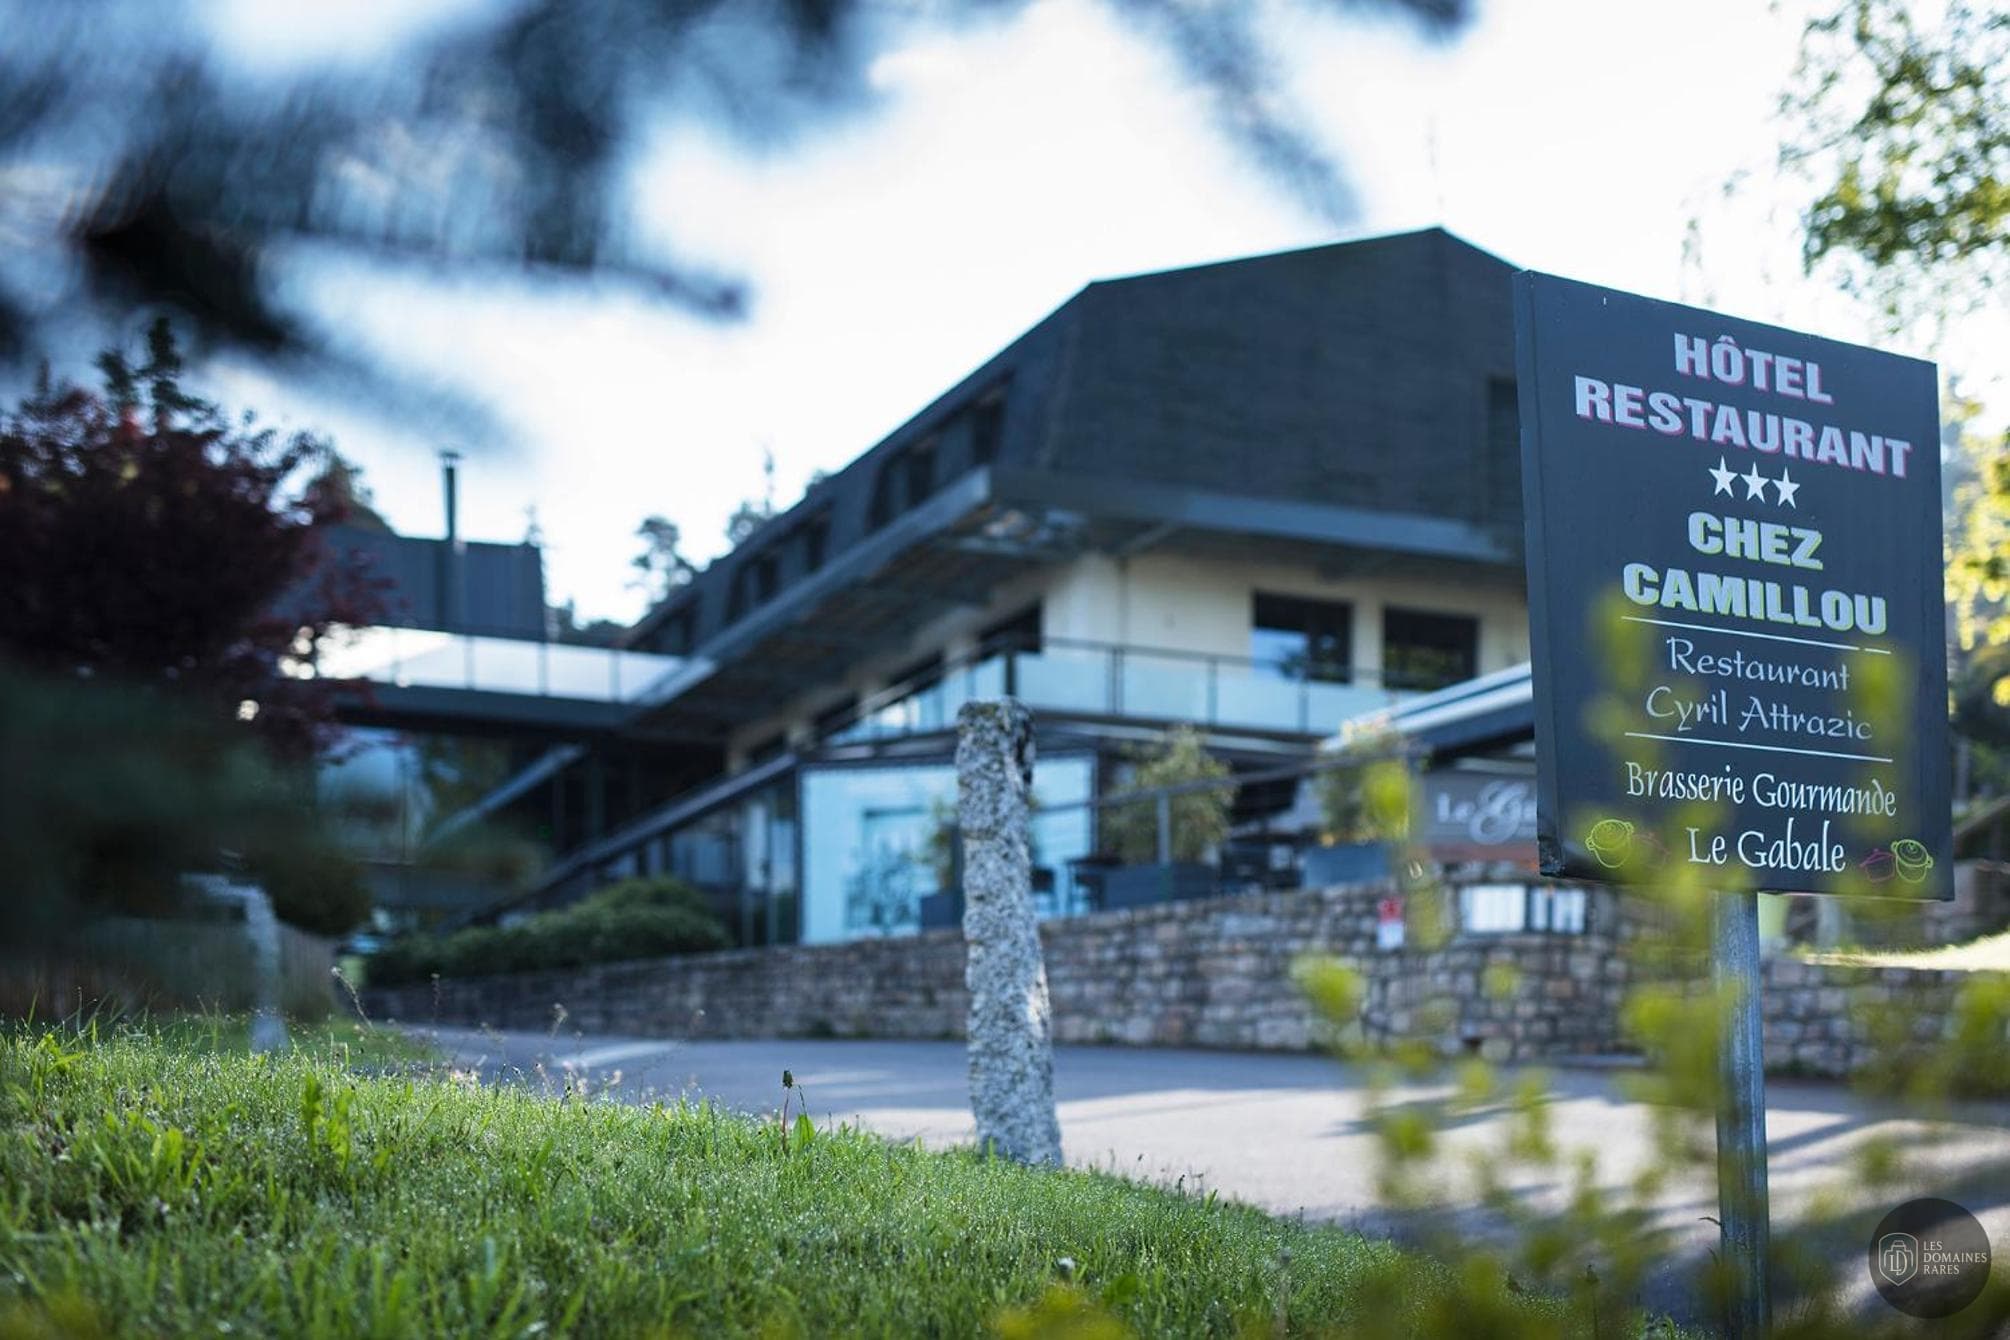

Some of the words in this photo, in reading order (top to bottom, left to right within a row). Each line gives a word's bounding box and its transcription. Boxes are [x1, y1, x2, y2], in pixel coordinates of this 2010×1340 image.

[1674, 333, 1834, 404] HÔTEL
[1575, 375, 1913, 478] RESTAURANT
[1688, 511, 1823, 570] CHEZ
[1623, 563, 1887, 635] CAMILLOU
[1667, 636, 1850, 691] Restaurant
[1646, 685, 1728, 732] Cyril
[1738, 696, 1873, 740] Attrazic
[1625, 762, 1745, 803] Brasserie
[1752, 773, 1897, 816] Gourmande
[1686, 826, 1728, 865] Le
[1737, 817, 1846, 872] Gabale
